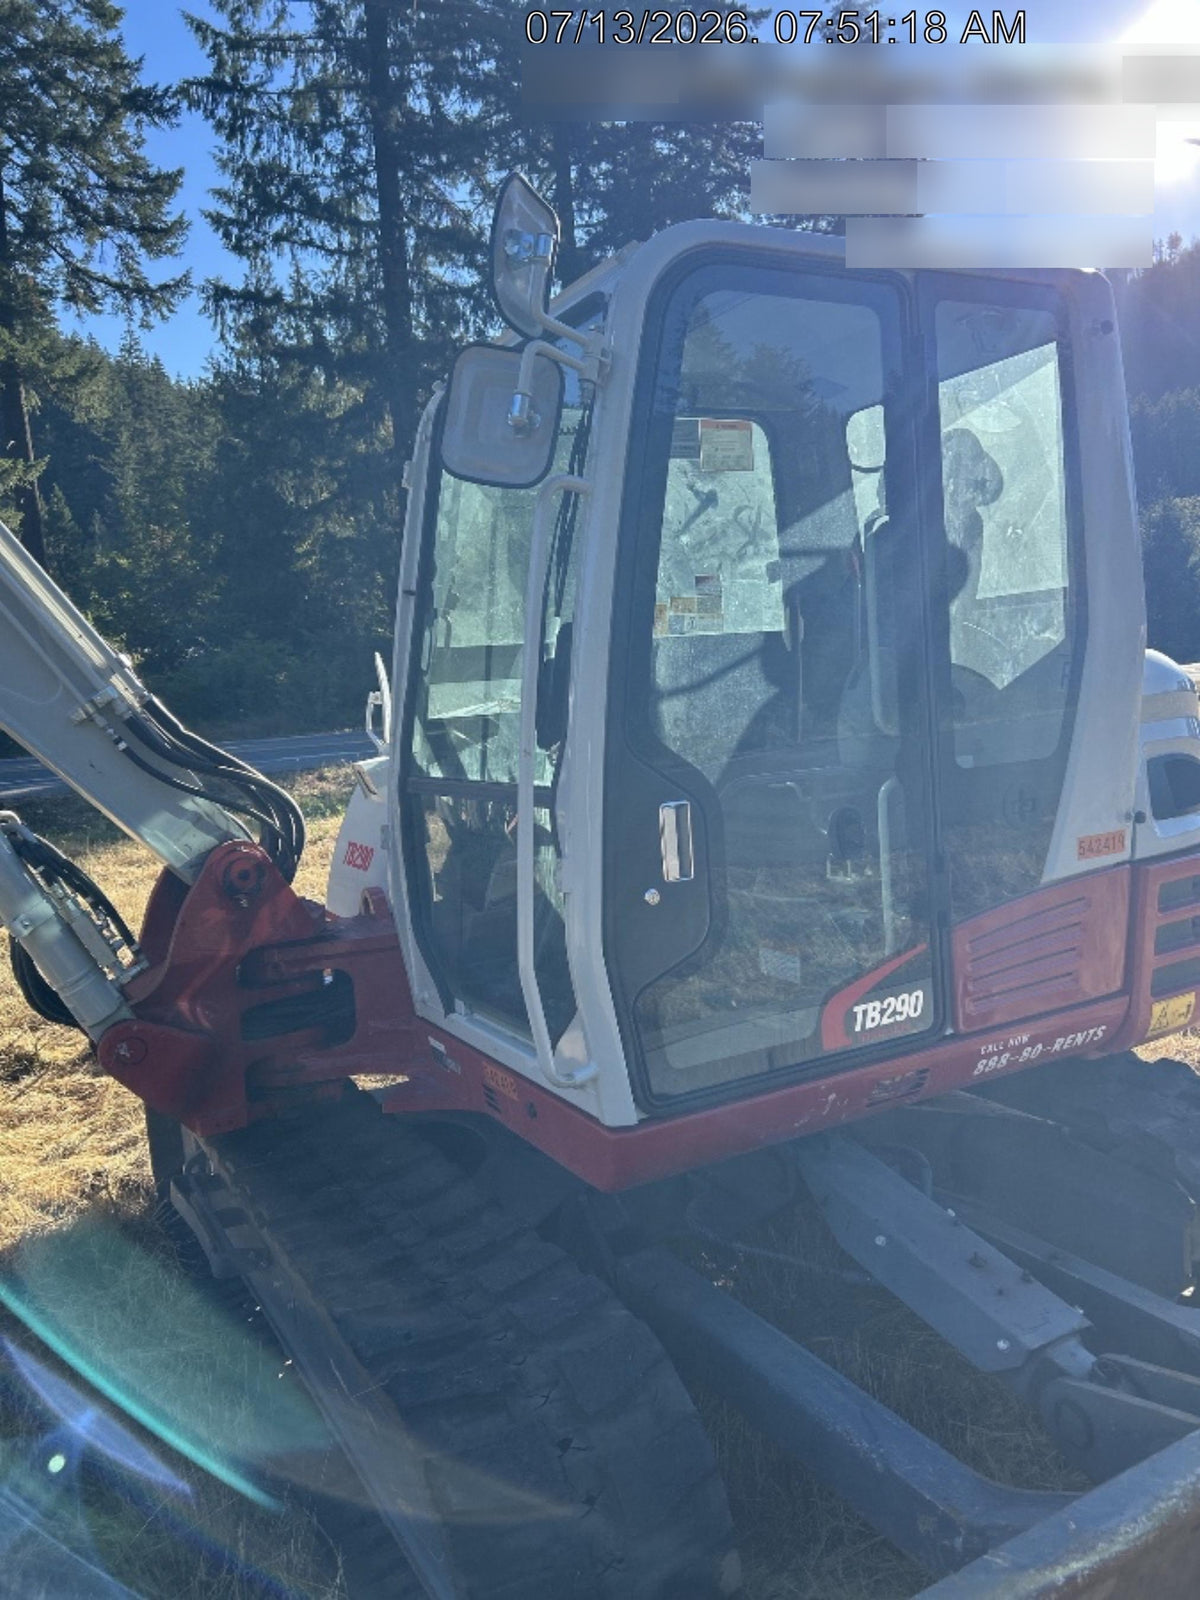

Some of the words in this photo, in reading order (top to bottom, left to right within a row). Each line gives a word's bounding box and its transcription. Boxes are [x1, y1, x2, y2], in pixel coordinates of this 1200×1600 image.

[343, 841, 374, 871] TB290
[852, 989, 924, 1033] TB290
[980, 1041, 1004, 1055] CALL
[1008, 1033, 1031, 1048] NOW
